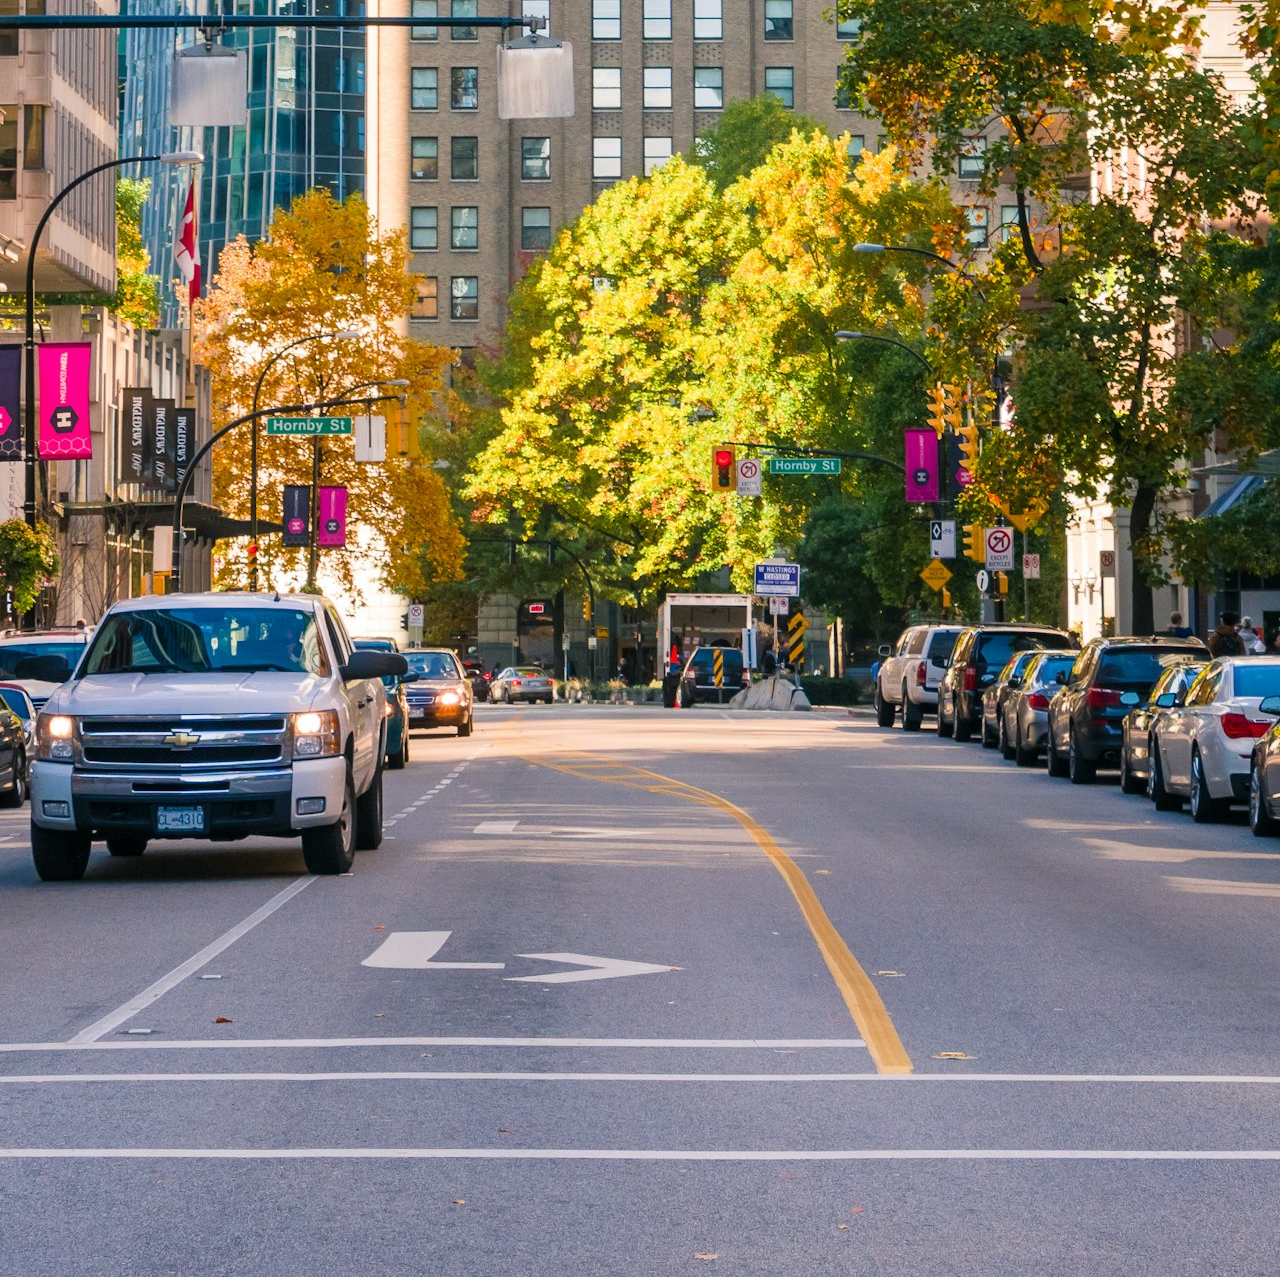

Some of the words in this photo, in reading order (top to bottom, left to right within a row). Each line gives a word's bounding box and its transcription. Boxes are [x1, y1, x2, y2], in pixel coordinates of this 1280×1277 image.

[273, 420, 323, 432] Hornby
[330, 420, 345, 431] St
[776, 461, 816, 472] Hornby
[822, 461, 835, 471] St
[766, 566, 796, 574] HASTINGS
